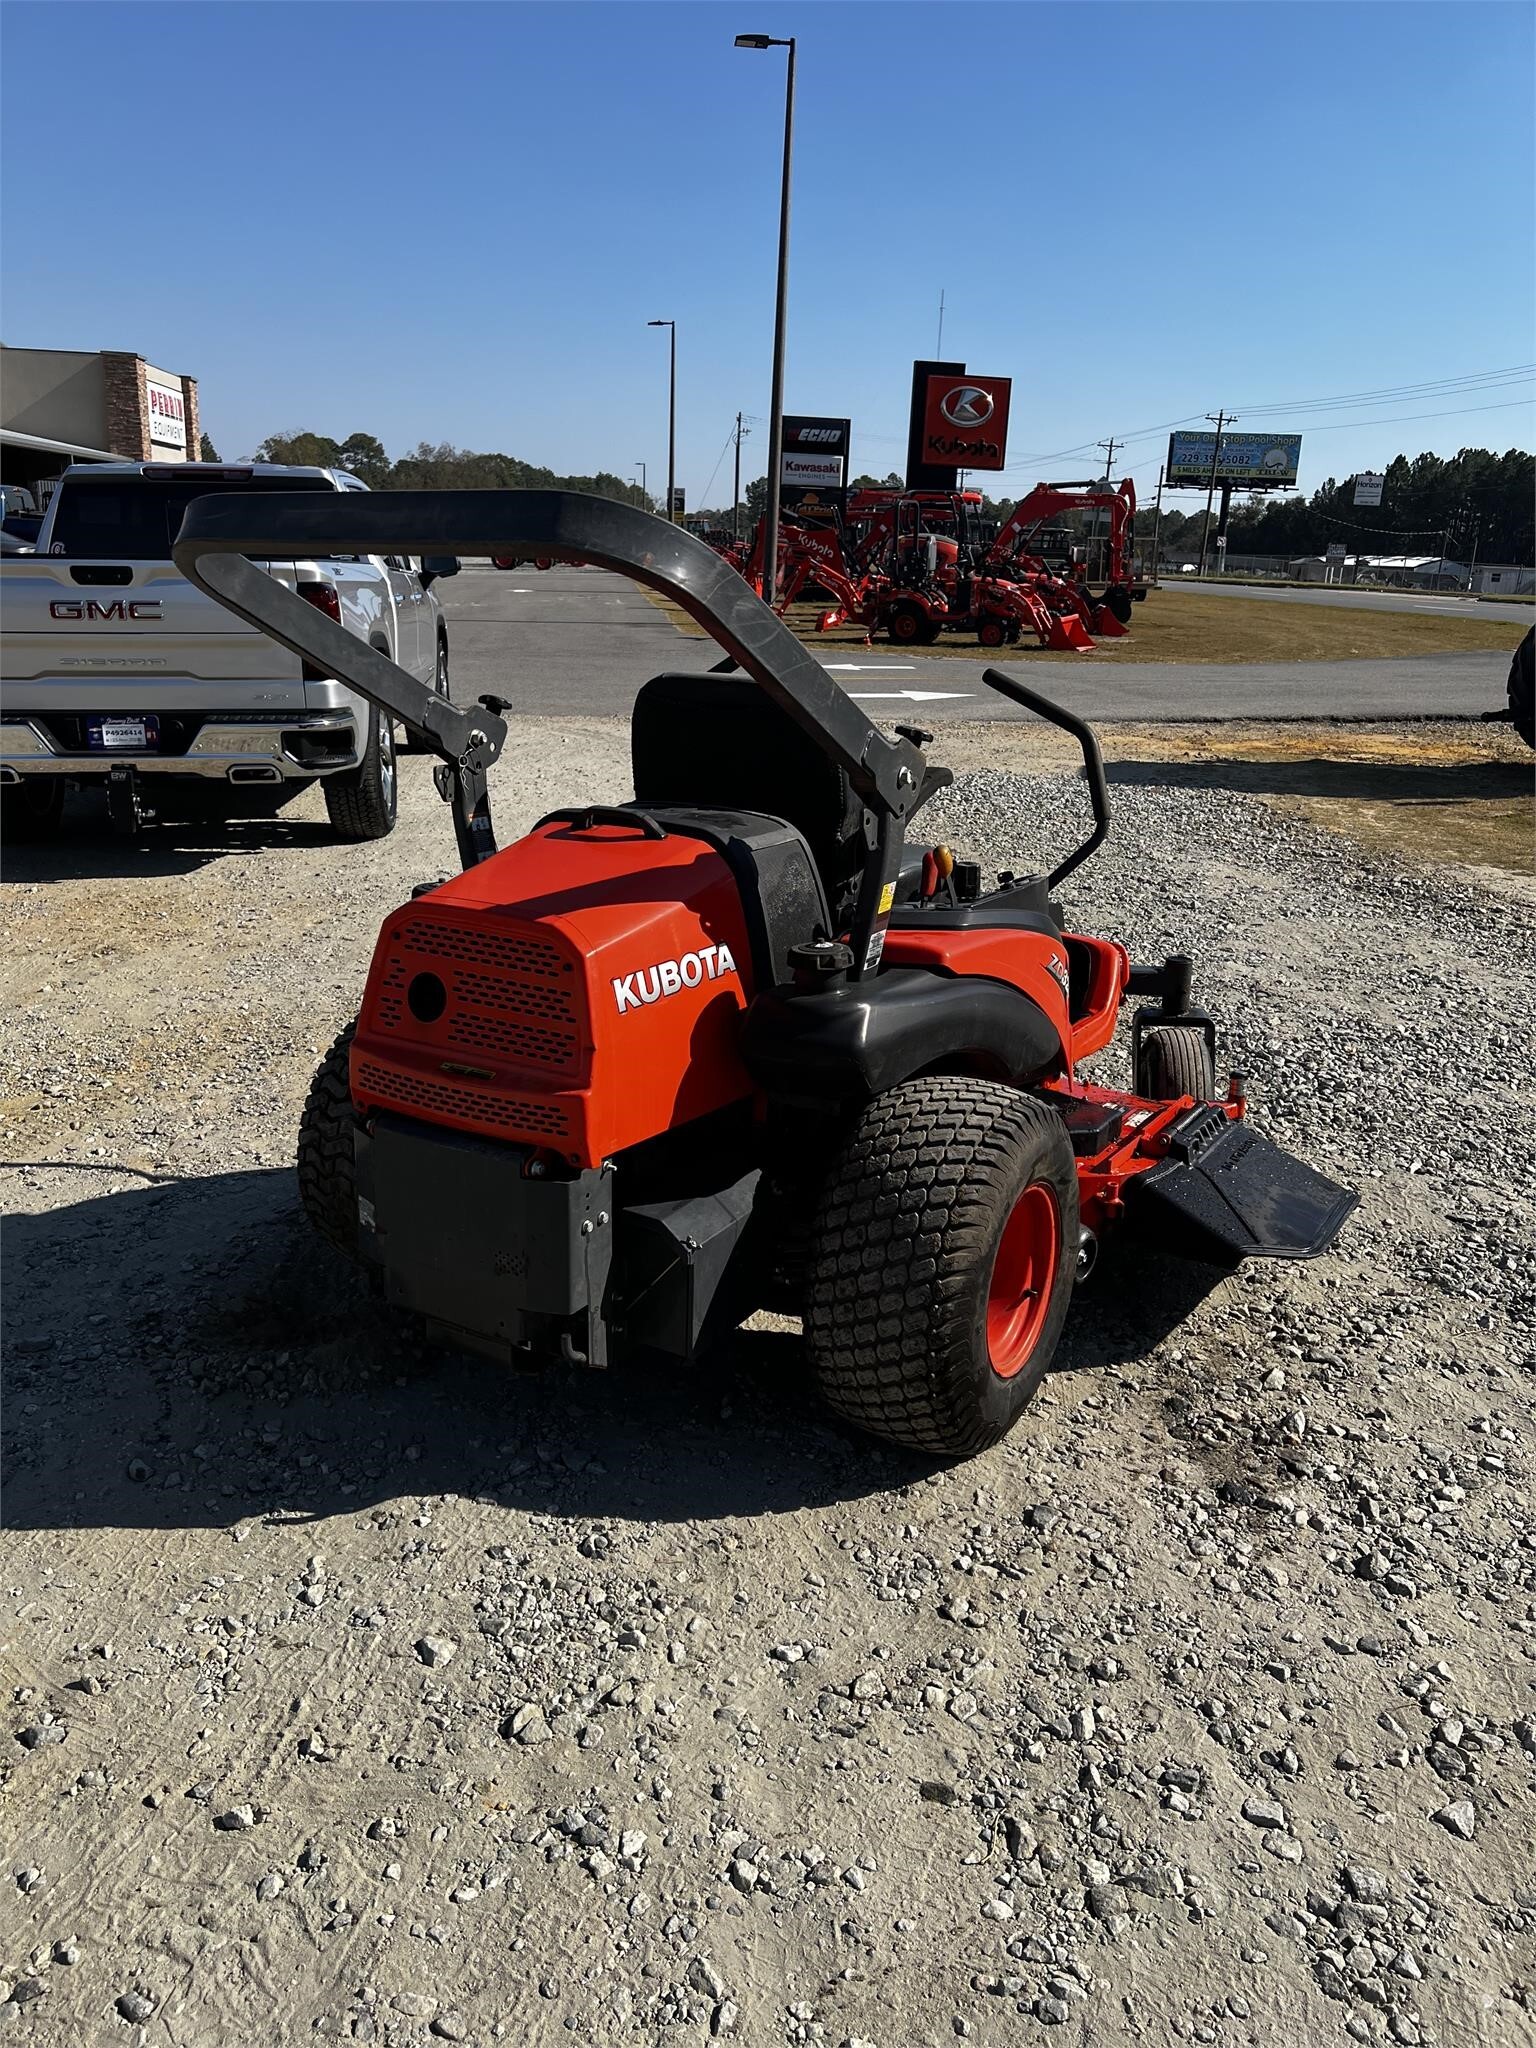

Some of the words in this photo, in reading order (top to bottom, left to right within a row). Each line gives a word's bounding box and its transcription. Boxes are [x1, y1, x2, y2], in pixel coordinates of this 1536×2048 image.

[150, 389, 183, 420] PERRIN
[798, 428, 842, 442] ECHO
[1180, 433, 1200, 442] Your
[1202, 433, 1246, 444] On-Stop
[1248, 435, 1269, 444] Pool
[1271, 436, 1298, 446] Shop!
[928, 435, 1000, 457] Kubota
[785, 461, 840, 473] Kawasaki
[798, 533, 834, 559] Kubota
[49, 600, 164, 621] GMC
[58, 657, 168, 666] SIERRA
[610, 941, 737, 1014] KUBOTA
